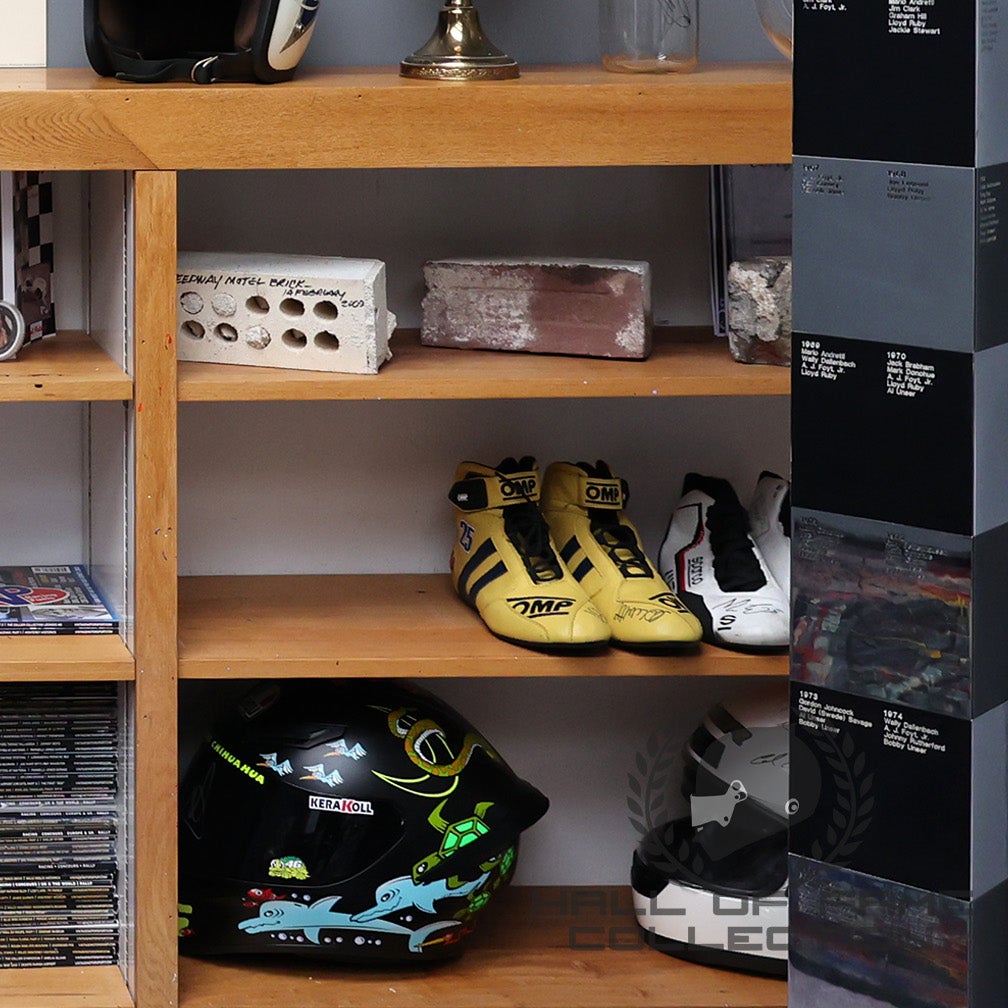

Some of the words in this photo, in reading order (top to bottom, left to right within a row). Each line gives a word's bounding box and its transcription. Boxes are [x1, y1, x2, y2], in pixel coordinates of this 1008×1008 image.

[913, 27, 940, 35] Stewart
[224, 276, 264, 286] MOTEL
[269, 278, 306, 288] BRICK
[886, 352, 906, 360] 1970
[500, 478, 537, 498] OMP
[586, 486, 620, 504] OMP
[460, 522, 475, 552] 25
[512, 598, 574, 616] OMP
[883, 710, 904, 720] 1974
[212, 740, 265, 786] CHIHUAHUA
[310, 796, 372, 814] KERAKOLL
